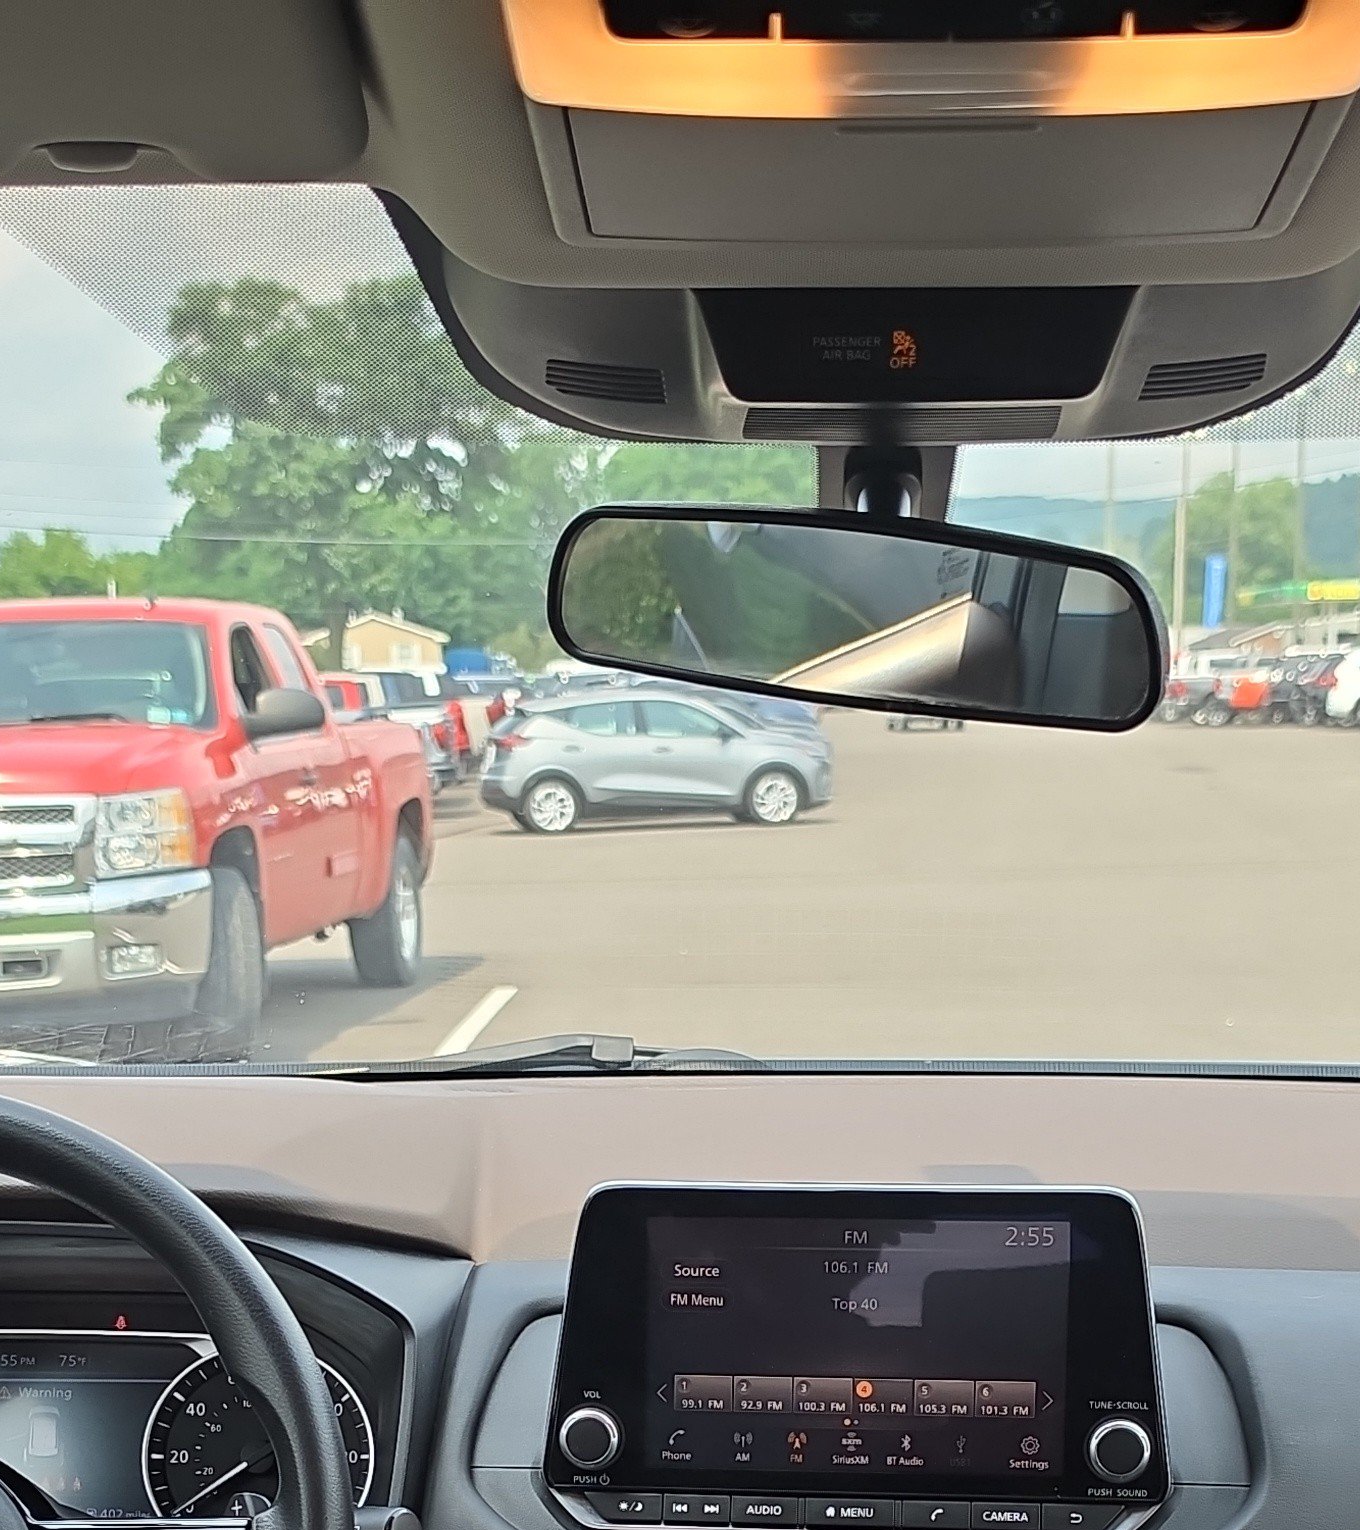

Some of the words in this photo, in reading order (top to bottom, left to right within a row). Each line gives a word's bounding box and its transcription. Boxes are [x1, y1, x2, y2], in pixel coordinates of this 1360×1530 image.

[812, 336, 881, 347] PASSENGER
[846, 350, 871, 361] BAG
[889, 357, 917, 369] OFF
[844, 1230, 868, 1244] FM
[1004, 1226, 1055, 1247] 2:55
[673, 1263, 720, 1278] Source
[823, 1261, 858, 1274] 106.1
[868, 1261, 889, 1274] FM
[669, 1293, 688, 1306] FM
[691, 1294, 724, 1307] Menu
[831, 1298, 857, 1313] Top
[860, 1298, 878, 1310] 40
[20, 1357, 36, 1366] PM
[18, 1386, 73, 1401] Warning
[583, 1390, 602, 1399] VOL
[185, 1402, 206, 1417] 40
[681, 1400, 703, 1409] 99.1
[708, 1400, 724, 1409] FM
[740, 1401, 763, 1410] 92.9
[767, 1401, 783, 1410] FM
[798, 1402, 825, 1411] 100.3
[830, 1402, 846, 1412] FM
[858, 1403, 885, 1413] 106.1
[890, 1404, 907, 1413] FM
[919, 1404, 947, 1414] 105.3
[951, 1404, 968, 1414] FM
[980, 1405, 1008, 1415] 101.3
[1013, 1406, 1029, 1415] FM
[210, 1424, 222, 1433] 60
[169, 1450, 189, 1464] 20
[661, 1451, 692, 1461] Phone
[734, 1452, 751, 1462] AM
[790, 1453, 803, 1463] FM
[831, 1455, 870, 1465] SiriusXM
[886, 1456, 898, 1466] BT
[899, 1456, 925, 1467] Audio
[1008, 1459, 1050, 1471] Settings
[202, 1466, 214, 1476] 20
[573, 1475, 597, 1484] PUSH
[1087, 1488, 1113, 1497] PUSH
[1116, 1489, 1148, 1498] SOUND
[746, 1504, 783, 1516] AUDIO
[840, 1506, 875, 1518] MENU
[982, 1510, 1029, 1523] CAMERA
